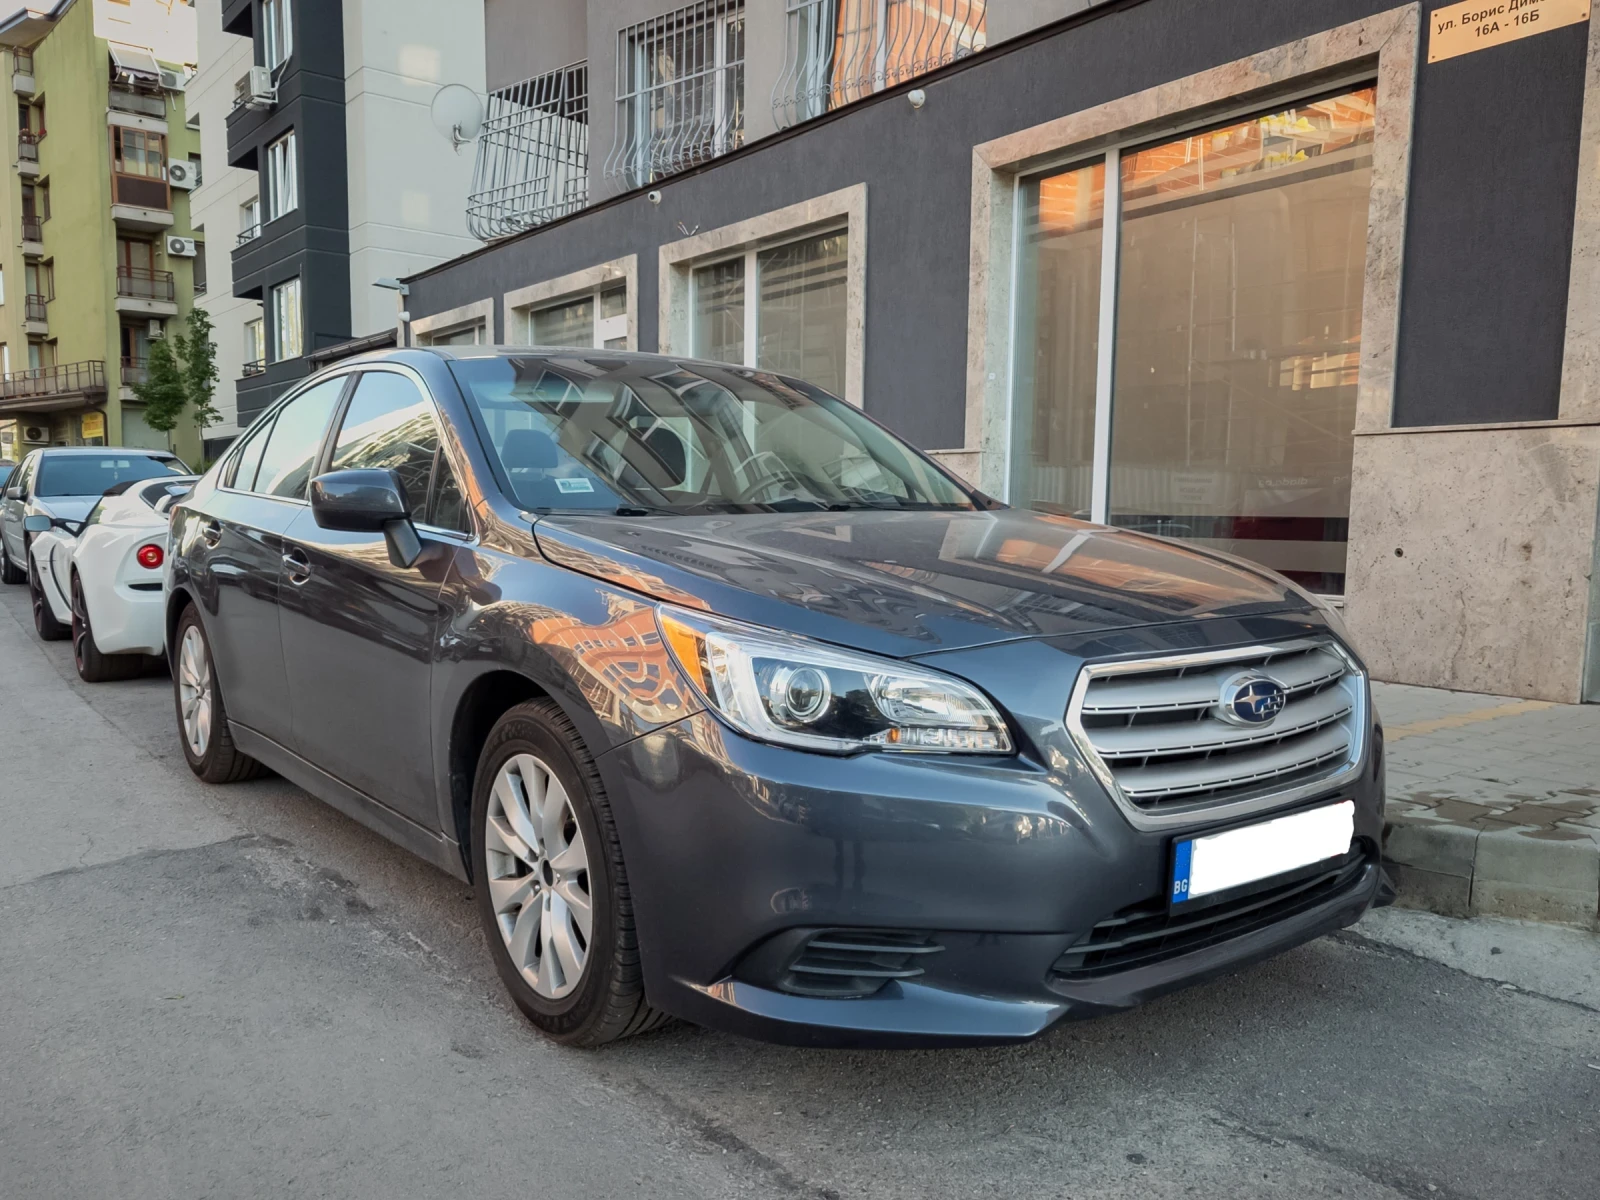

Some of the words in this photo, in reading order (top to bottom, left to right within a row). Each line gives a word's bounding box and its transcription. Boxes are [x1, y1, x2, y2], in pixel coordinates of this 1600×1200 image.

[1437, 20, 1457, 35] ул.
[1461, 4, 1505, 23] Борис
[1507, 0, 1546, 13] Дим
[1474, 21, 1500, 37] 16А
[1513, 9, 1540, 26] 16Б
[1173, 878, 1188, 895] BG
